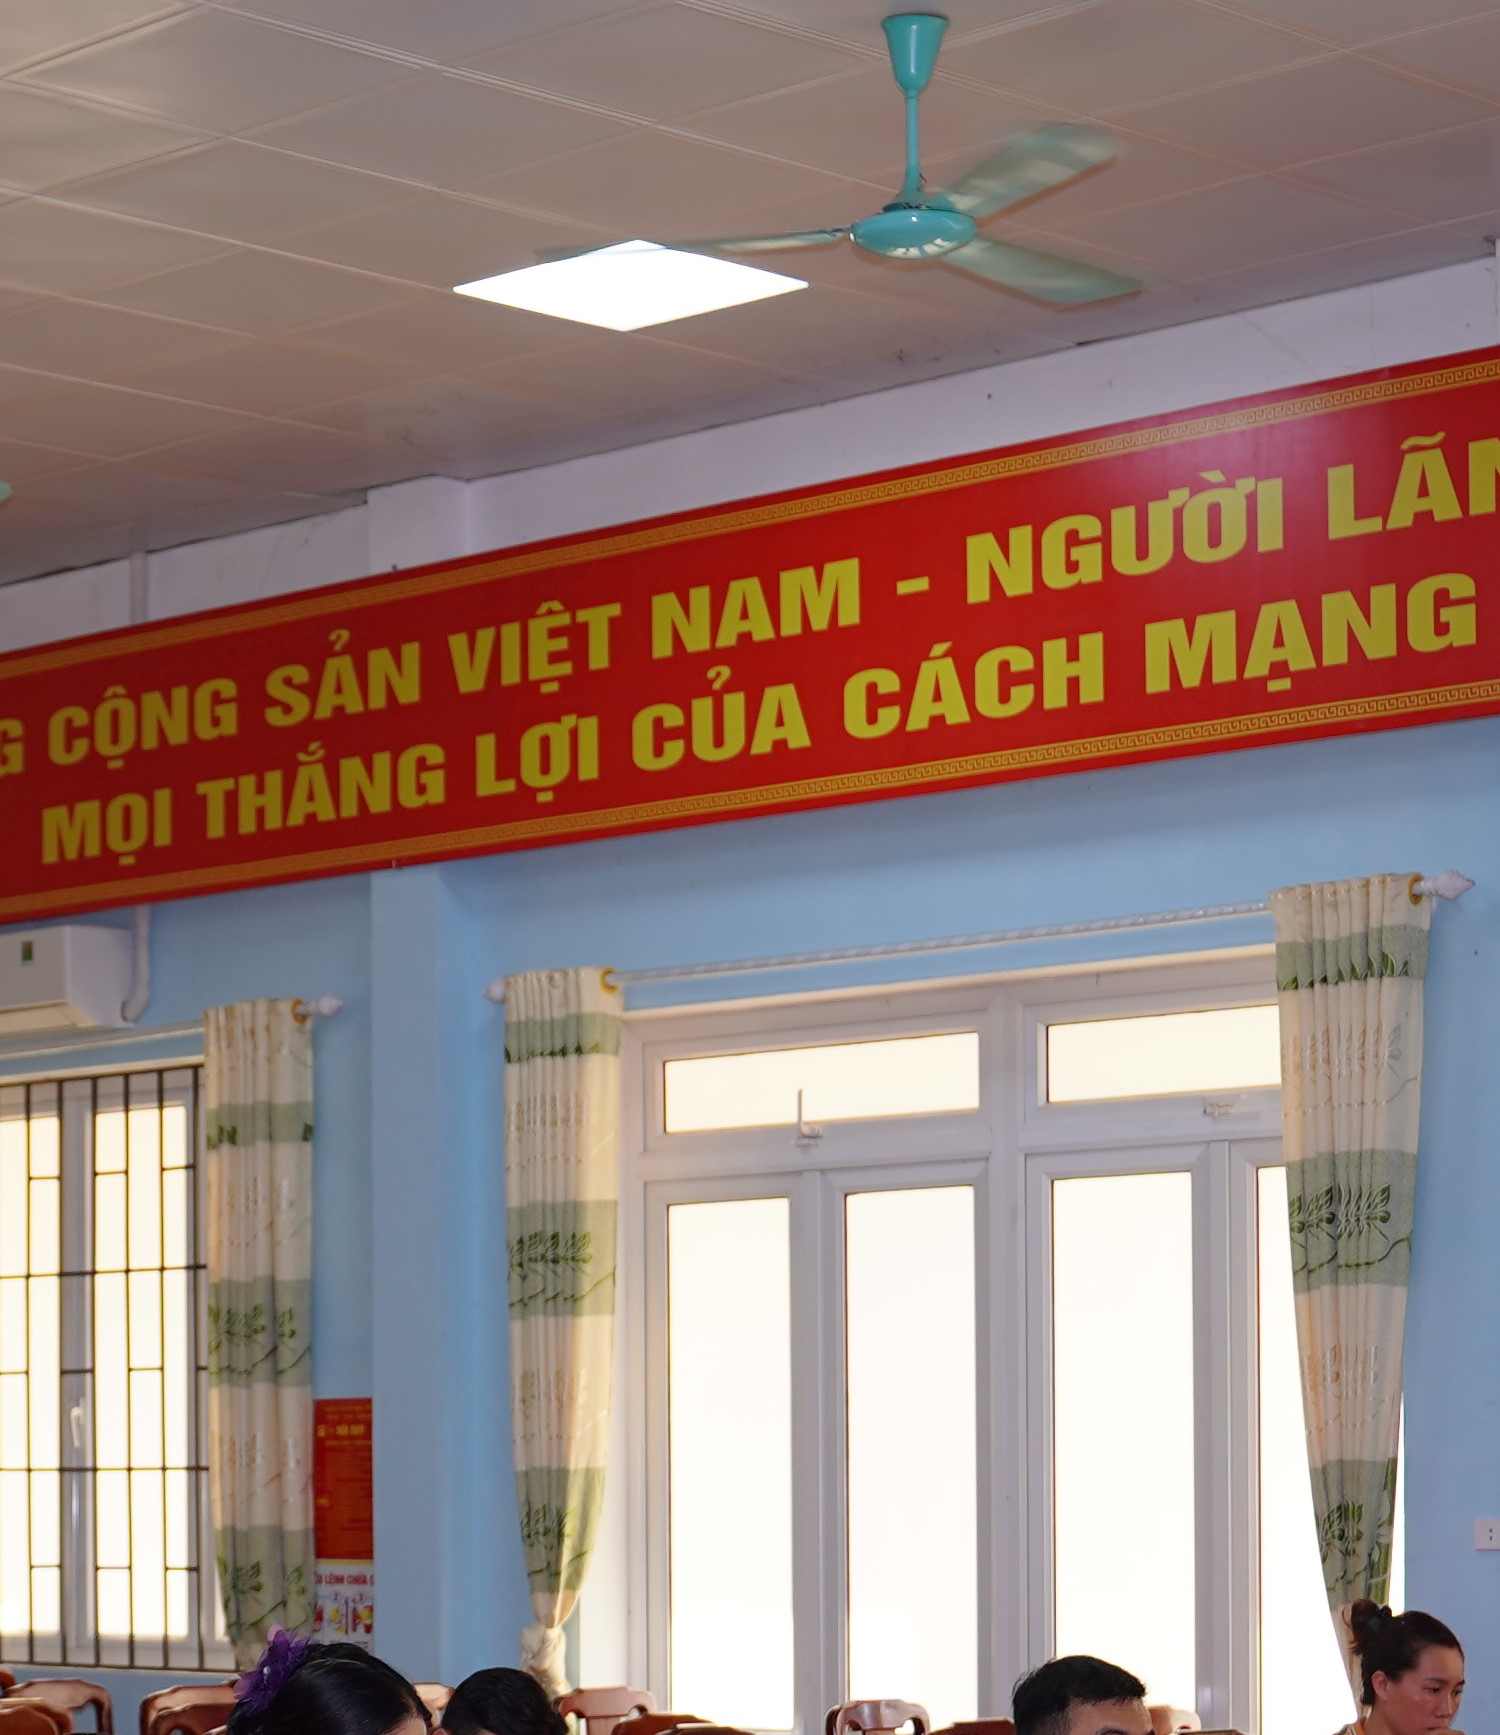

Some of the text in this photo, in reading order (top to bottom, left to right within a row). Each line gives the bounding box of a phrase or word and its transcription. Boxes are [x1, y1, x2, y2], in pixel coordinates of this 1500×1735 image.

[43, 789, 171, 865] MỌI
[197, 741, 446, 838] THẮNG
[475, 713, 600, 803] LỢI
[632, 664, 812, 772] CỦA
[843, 631, 1105, 740] CÁCH
[1144, 573, 1477, 694] MẠNG
[49, 680, 237, 769] CỘNG
[265, 630, 421, 726] SẢN
[448, 600, 622, 694] VIỆT
[651, 557, 862, 660] NAM
[896, 575, 931, 596] -
[966, 471, 1283, 605] NGƯỜI
